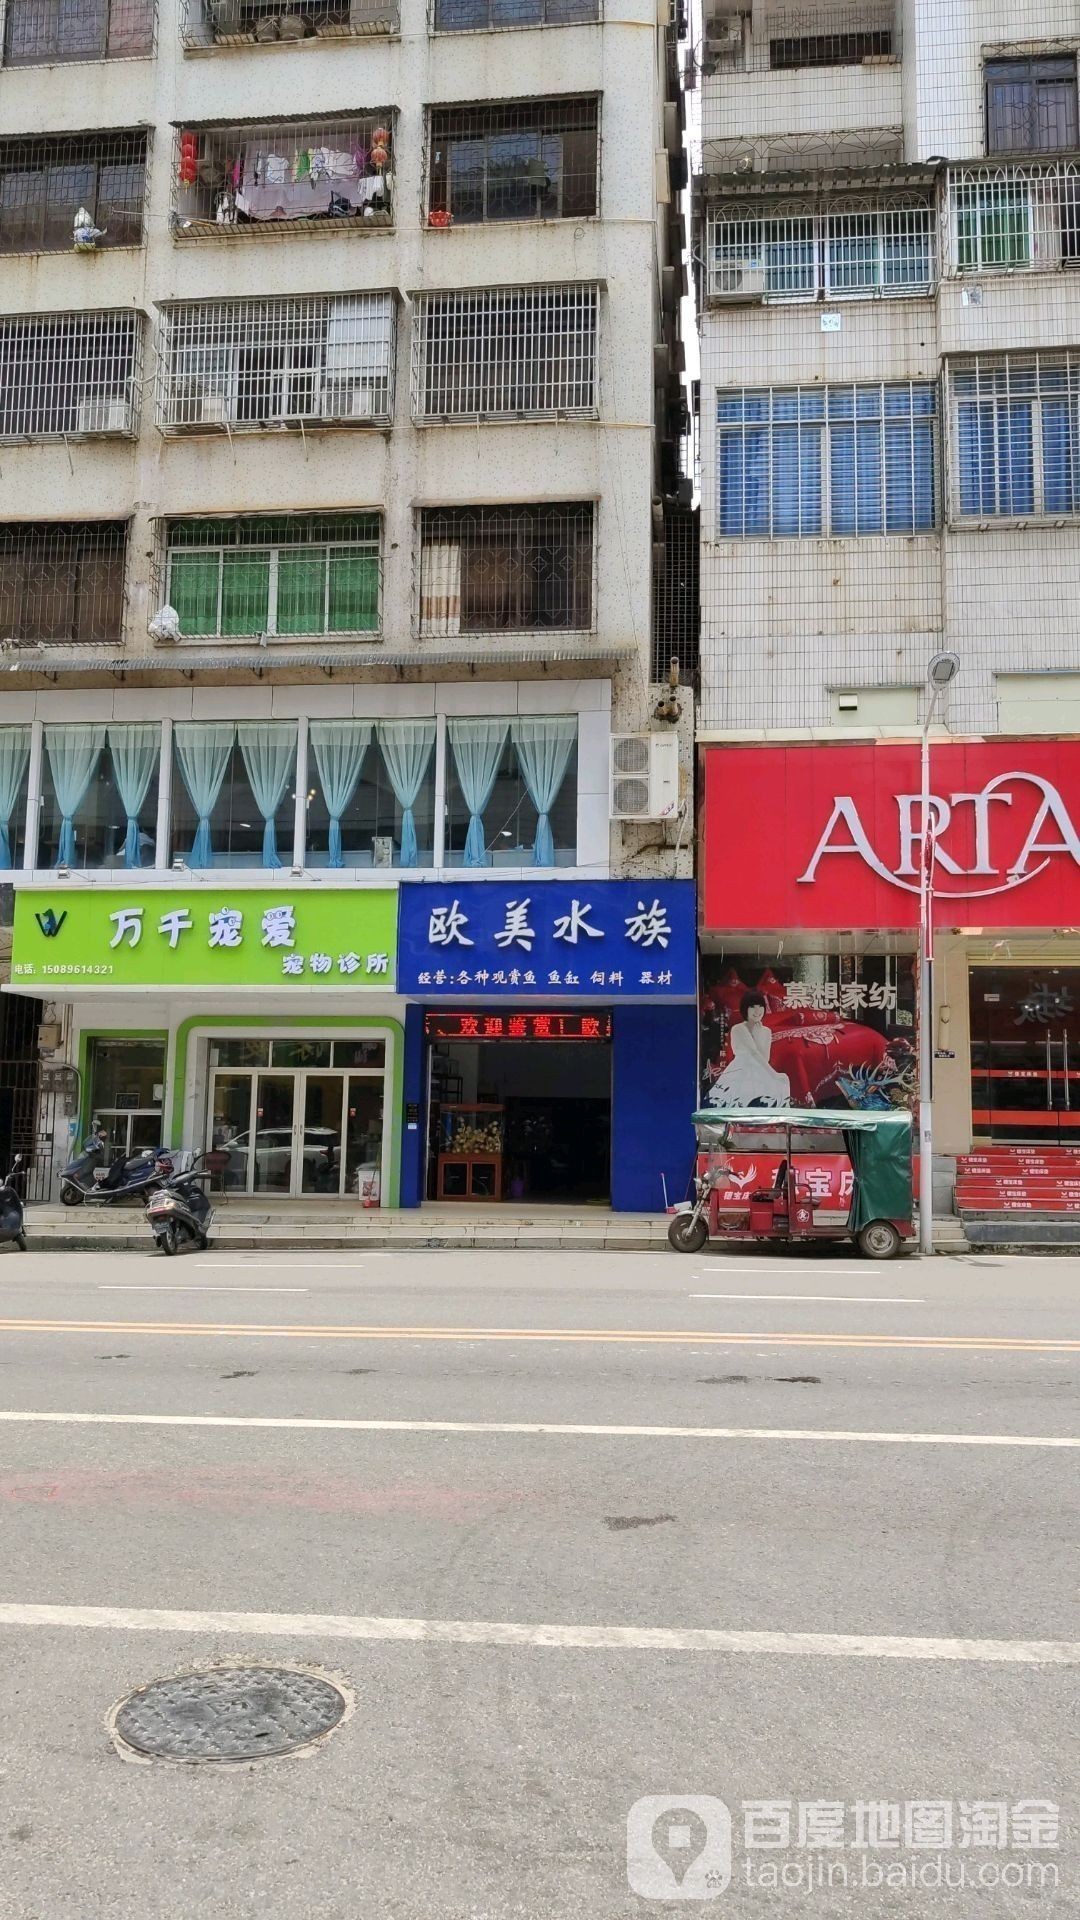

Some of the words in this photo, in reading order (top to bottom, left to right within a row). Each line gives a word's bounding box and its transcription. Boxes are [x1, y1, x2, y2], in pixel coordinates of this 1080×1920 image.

[109, 906, 296, 949] 万千宠爱
[428, 898, 672, 951] 欧美水族
[282, 952, 389, 974] 宠物诊所
[547, 971, 580, 985] 鱼缸
[590, 970, 624, 986] 饲料
[639, 970, 673, 985] 器材
